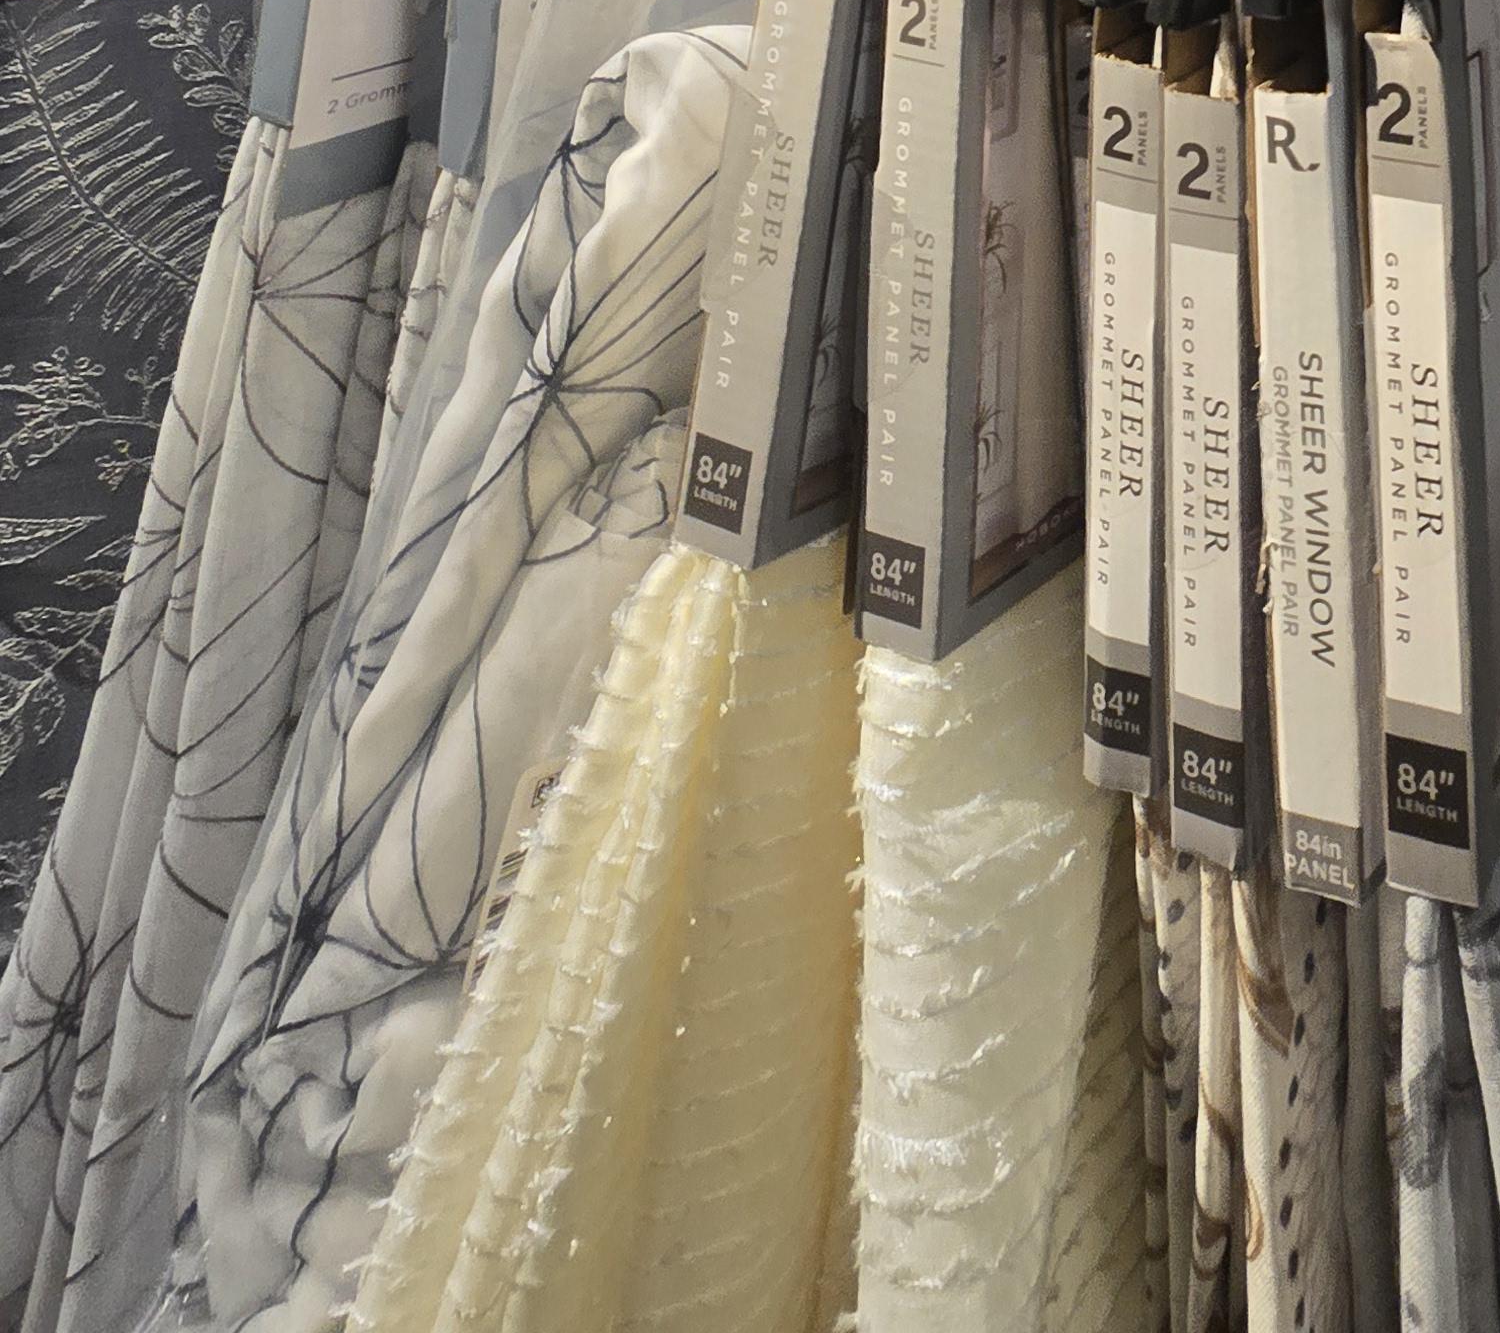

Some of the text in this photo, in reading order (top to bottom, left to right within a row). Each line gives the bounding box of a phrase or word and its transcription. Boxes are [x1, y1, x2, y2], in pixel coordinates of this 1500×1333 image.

[1103, 105, 1134, 162] 2
[1137, 110, 1149, 166] PANELS
[1378, 82, 1414, 145] 2
[1418, 86, 1428, 150] PANELS
[715, 0, 788, 389] GROMMET PANEL PAIR
[758, 131, 796, 268] SHEER
[1176, 142, 1212, 201] 2
[1216, 145, 1227, 204] PANELS
[879, 96, 913, 487] GROMMET PANEL PAIR
[908, 229, 935, 365] SHEER
[1097, 251, 1116, 586] GROMMET PANEL PAIR
[1119, 349, 1145, 498] SHEER
[1384, 252, 1411, 644] GROMMET PANEL PAIR
[697, 454, 743, 490] 84"
[1181, 295, 1197, 648] GROMMET PANEL PAIR
[1203, 396, 1230, 553] SHEER
[1410, 363, 1445, 538] SHEER
[694, 486, 738, 512] LENGTH
[1272, 365, 1299, 637] GROMMET PANEL PAIR
[1299, 351, 1336, 668] SHEER WINDOW
[870, 551, 916, 586] 84"
[870, 583, 915, 607] LENGTH
[1091, 708, 1141, 735] LENGTH
[1093, 682, 1139, 717] 84"
[1181, 778, 1235, 807] LENGTH
[1182, 749, 1233, 785] 84"
[1397, 763, 1455, 800] 84"
[1396, 796, 1458, 823] LENGTH
[1284, 852, 1356, 891] PANEL
[1296, 829, 1342, 861] 84in
